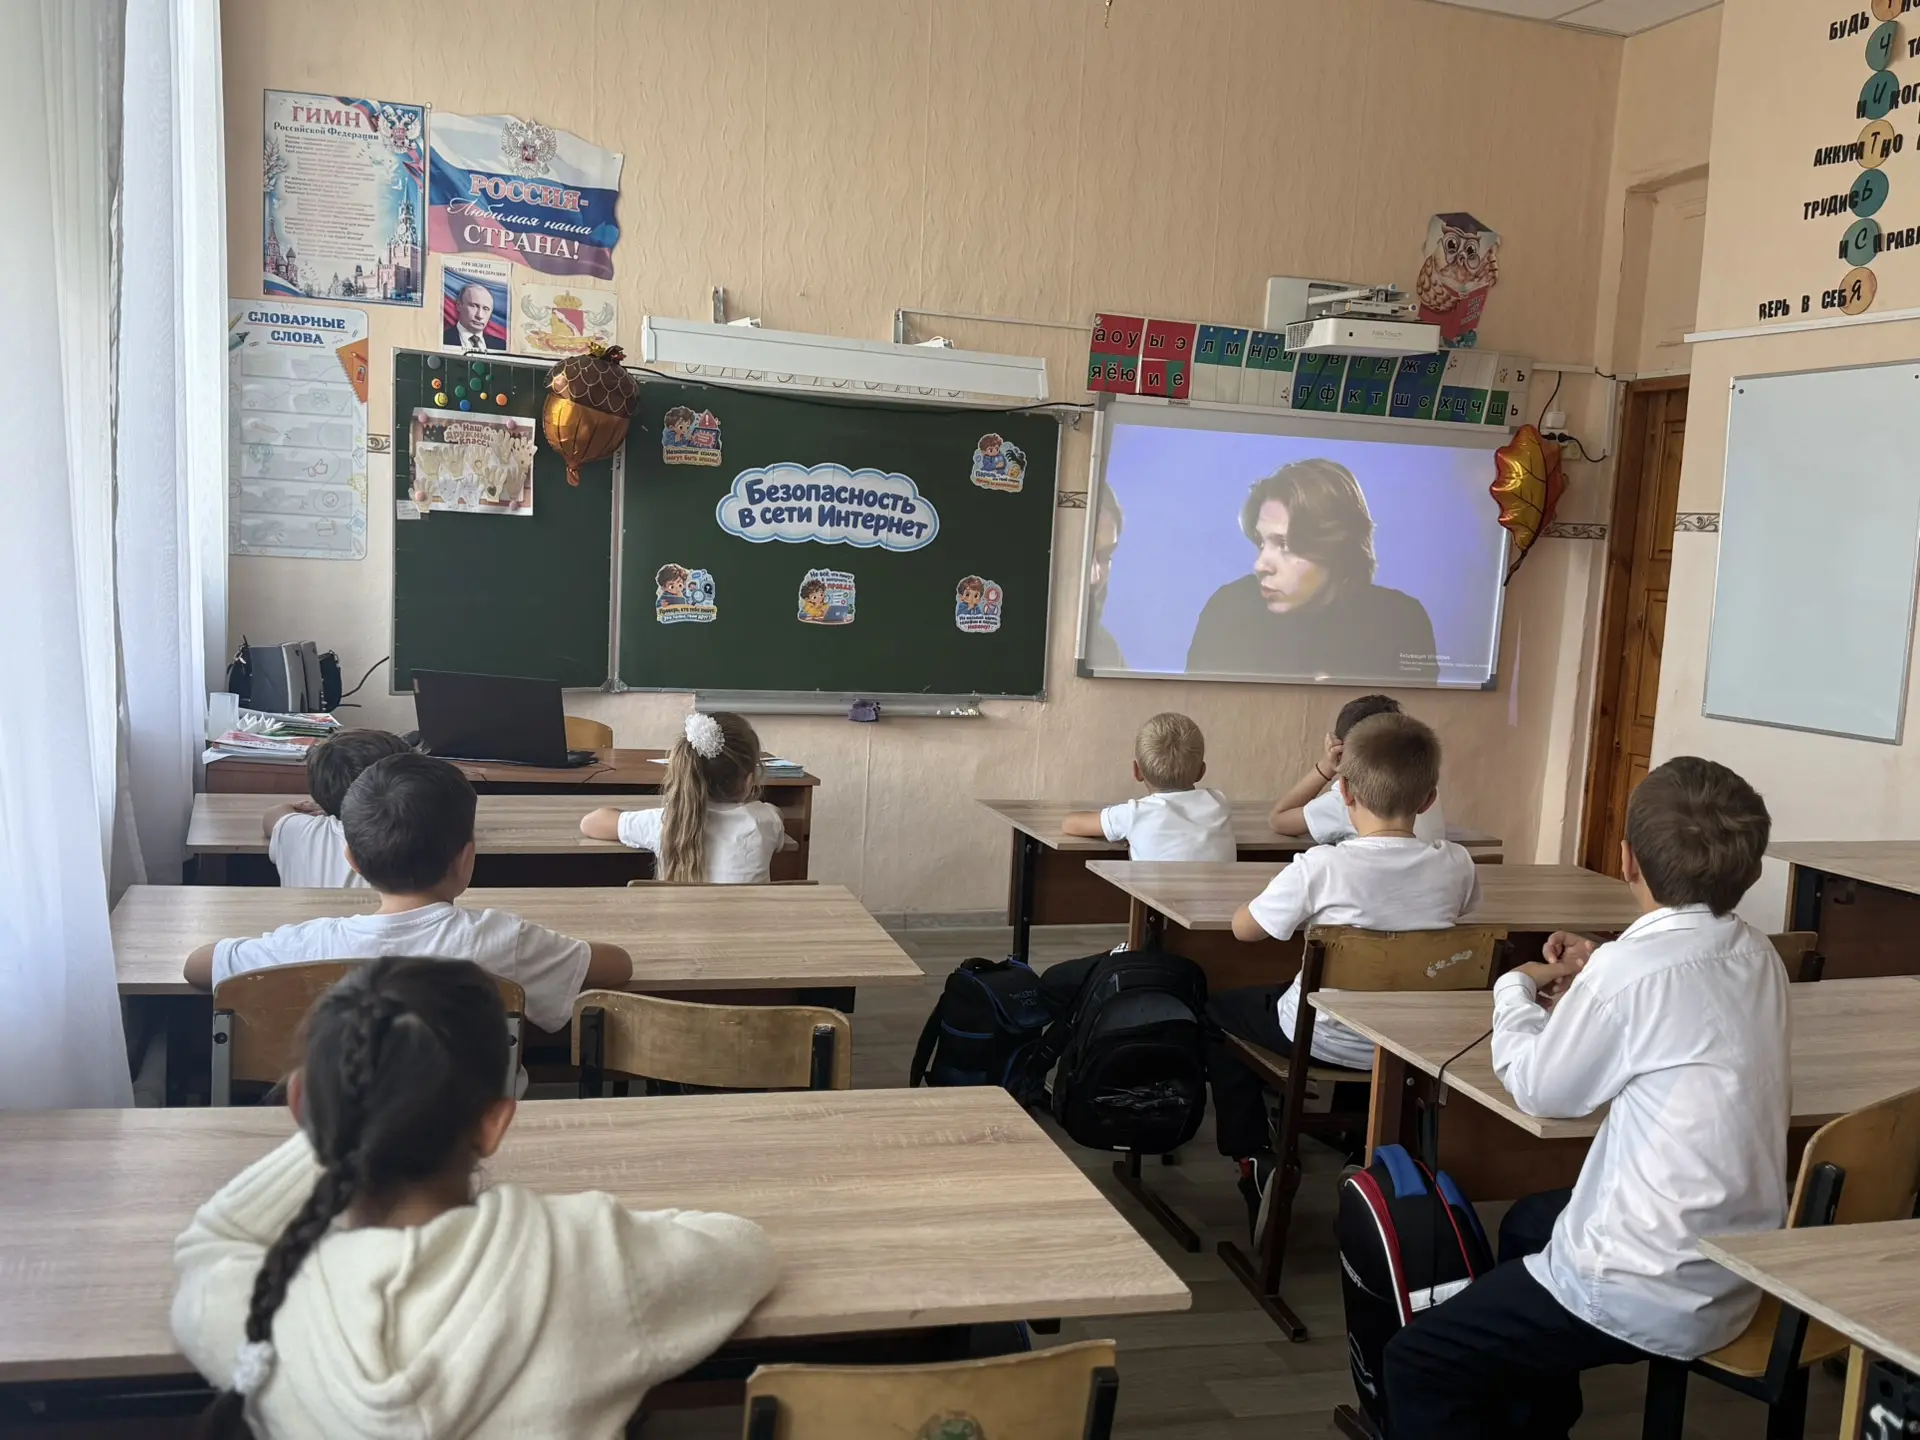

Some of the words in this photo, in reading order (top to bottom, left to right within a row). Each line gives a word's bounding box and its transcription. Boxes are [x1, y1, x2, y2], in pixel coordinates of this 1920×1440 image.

[1829, 11, 1870, 40] БУДЬ
[273, 121, 326, 135] Российской
[327, 127, 379, 142] Федерации
[291, 105, 361, 128] ГИМН
[1813, 132, 1904, 168] АККУРАТНО
[446, 197, 541, 226] Любимая
[543, 220, 593, 236] наша
[1803, 179, 1874, 221] ТРУДИСЬ
[463, 224, 580, 260] СТРАНА!
[1801, 295, 1810, 313] В
[1821, 279, 1862, 309] СЕБЯ
[247, 310, 346, 330] СЛОВАРНЫЕ
[270, 330, 325, 345] СЛОВА
[462, 424, 482, 432] Наш
[745, 478, 917, 515] Безопасность
[738, 507, 757, 529] в
[760, 504, 812, 525] сети
[817, 504, 929, 540] Интернет
